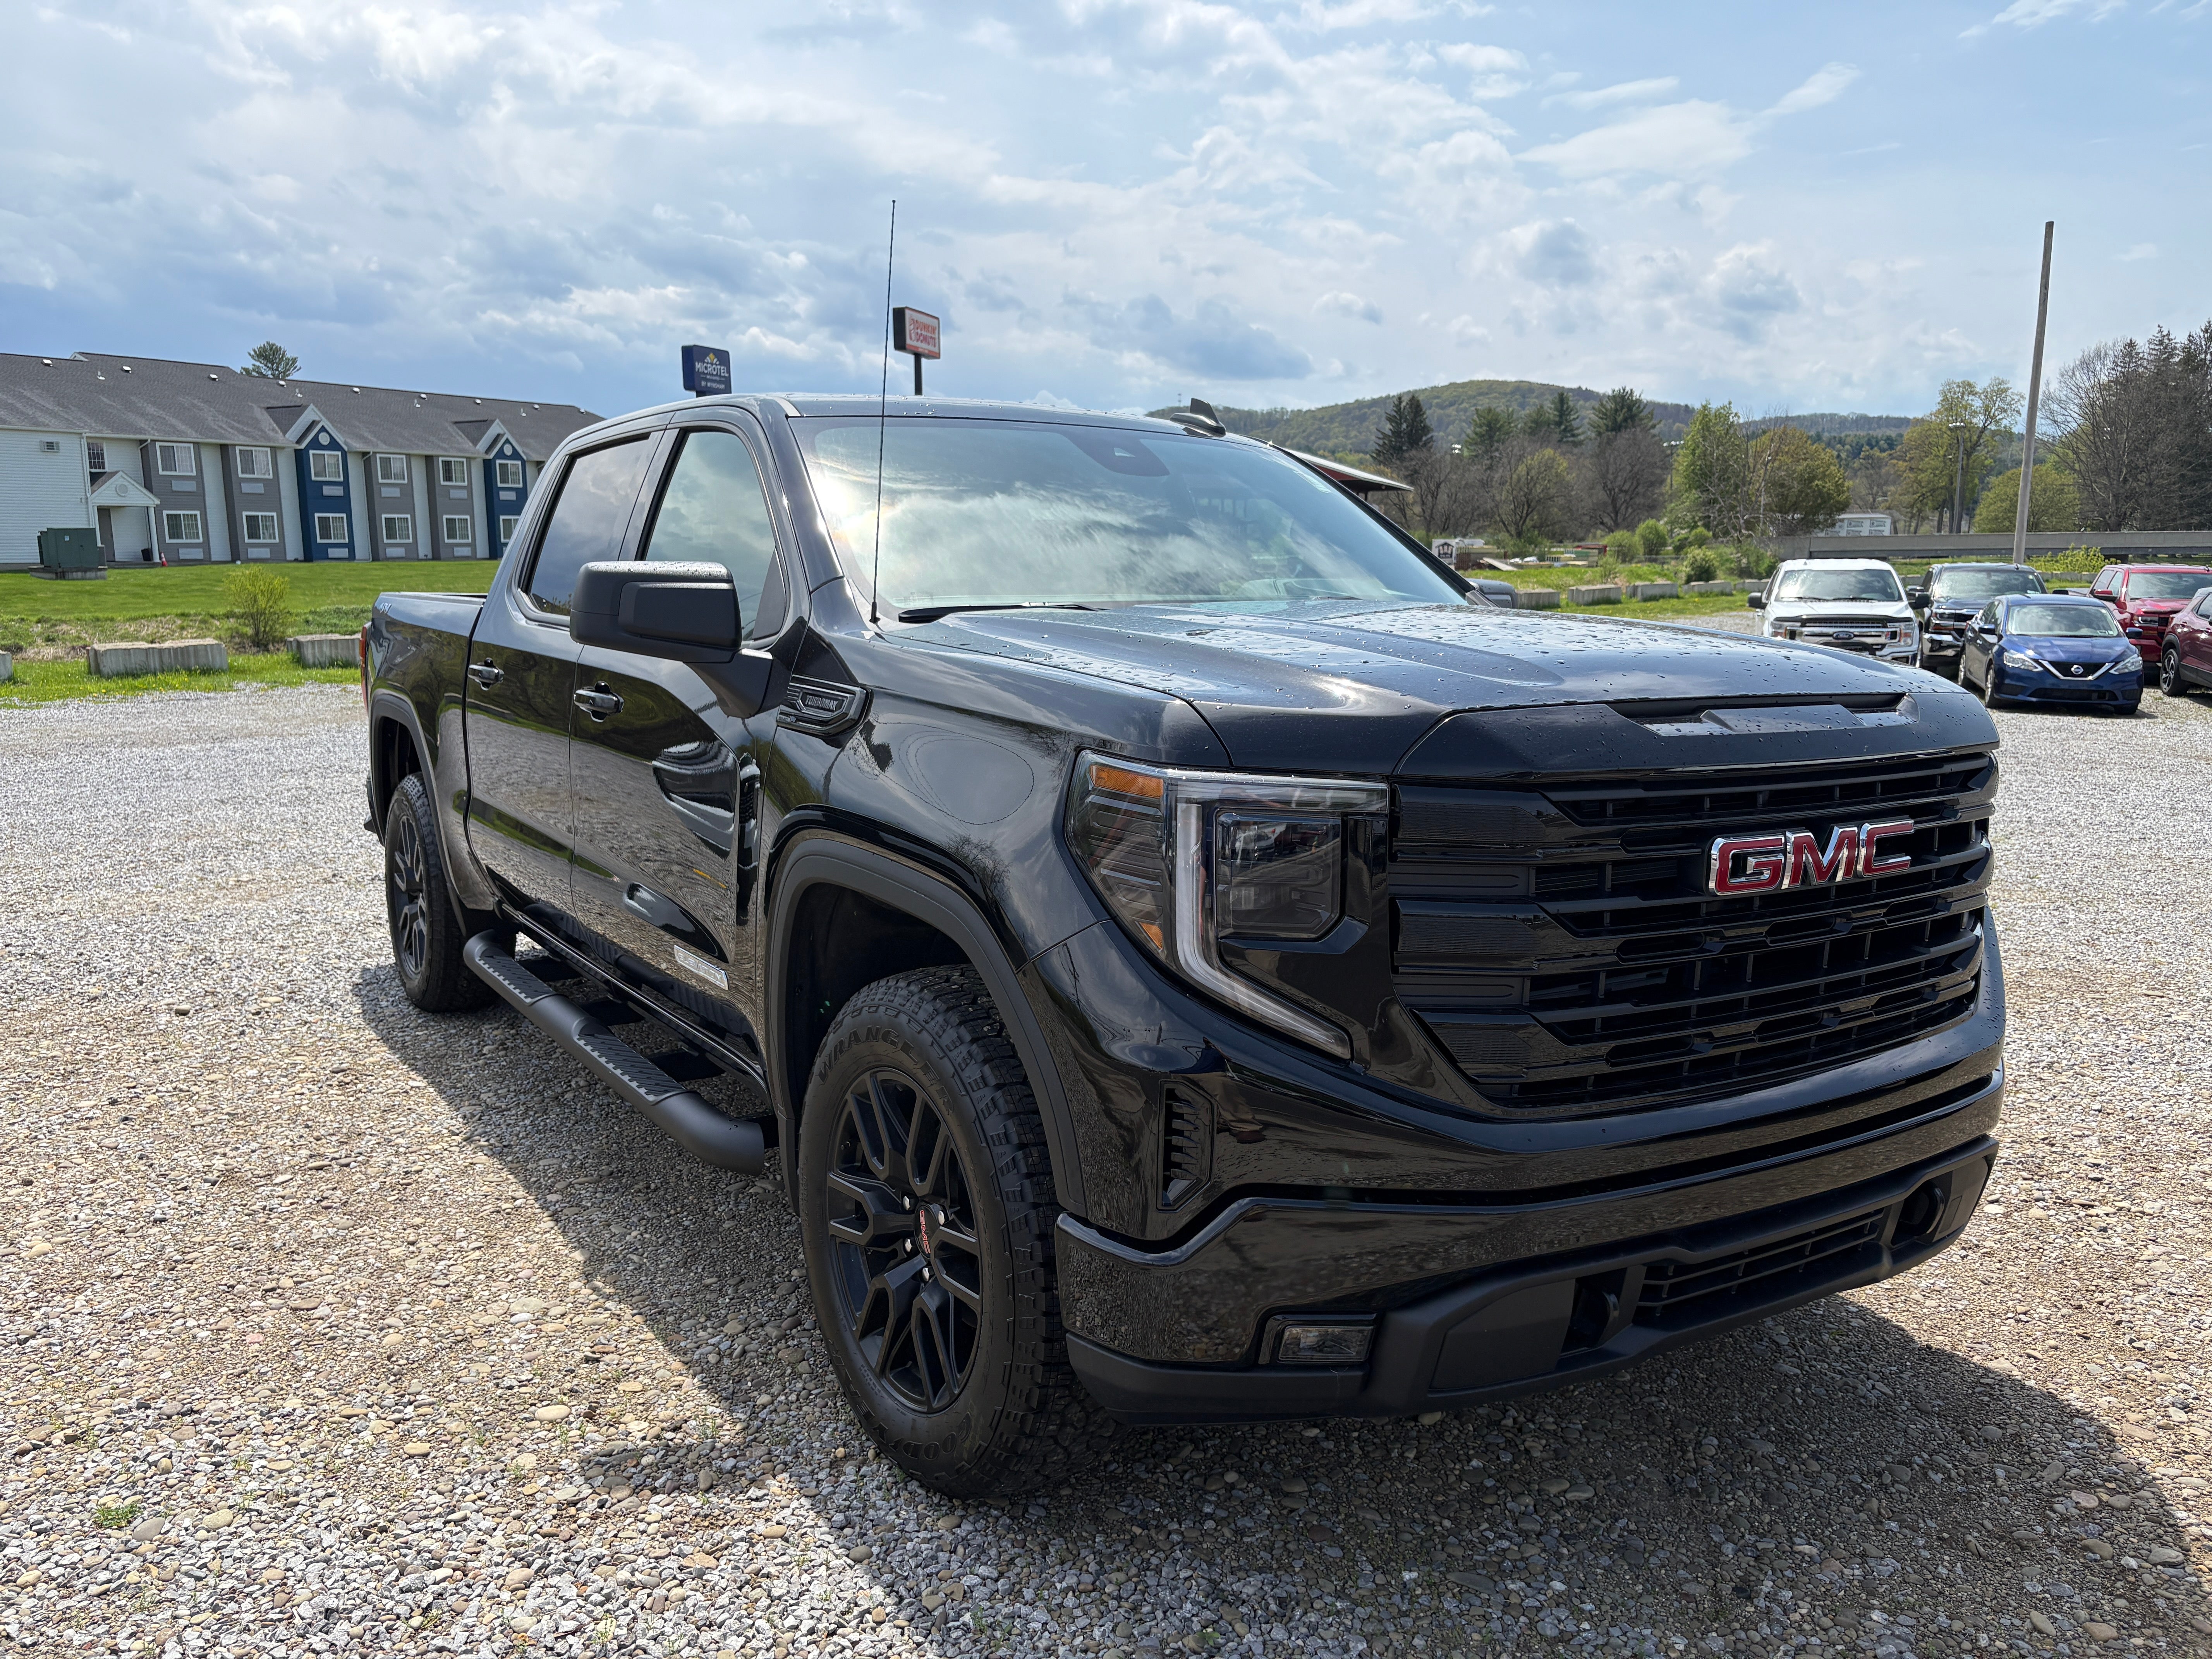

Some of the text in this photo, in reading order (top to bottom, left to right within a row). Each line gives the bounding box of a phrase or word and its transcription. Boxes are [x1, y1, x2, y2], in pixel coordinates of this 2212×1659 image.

[915, 331, 936, 348] DONUTS
[696, 362, 729, 377] MICROTEL
[805, 695, 838, 711] TURBOMAX
[1709, 820, 1915, 896] GMC
[817, 1025, 955, 1116] WRANGLER
[919, 1210, 931, 1254] GMC
[828, 1339, 972, 1461] GOODYEAR
